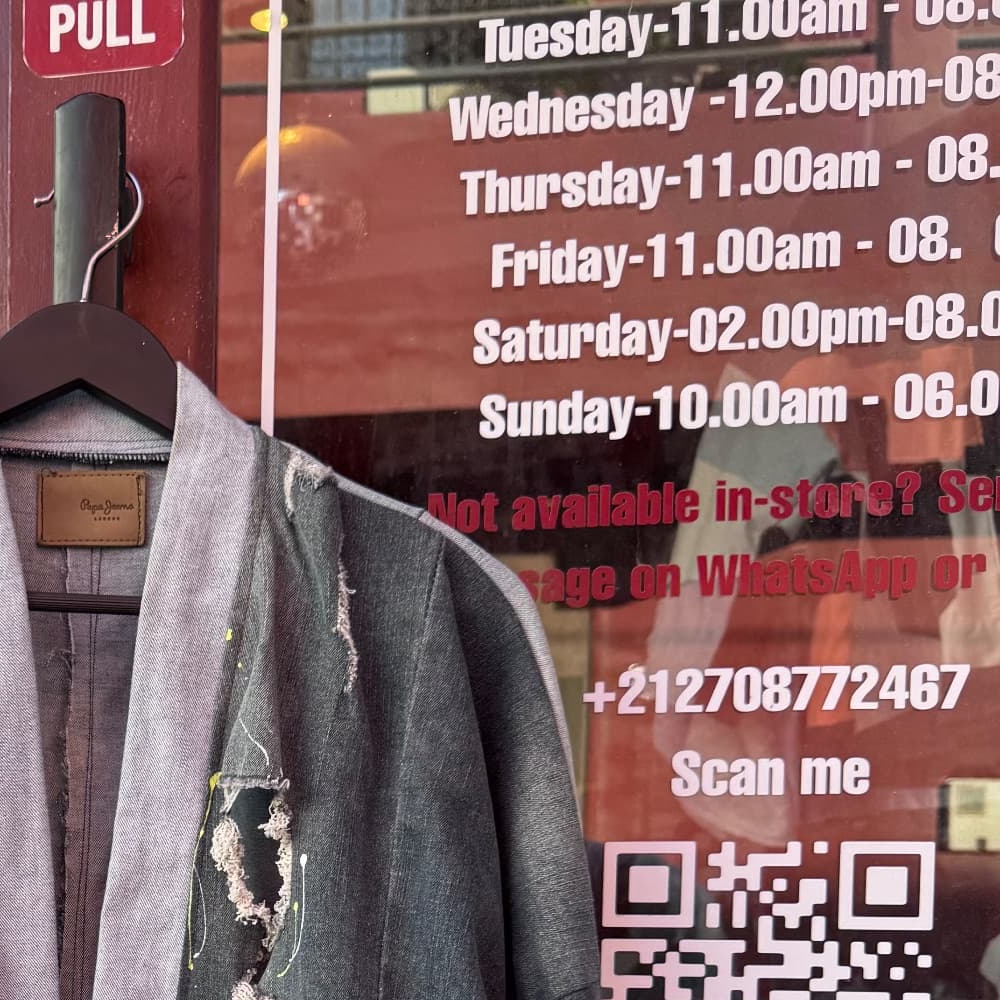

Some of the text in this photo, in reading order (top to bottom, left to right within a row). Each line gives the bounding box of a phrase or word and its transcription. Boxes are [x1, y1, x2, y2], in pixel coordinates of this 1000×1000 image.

[50, 0, 155, 53] PULL
[449, 82, 695, 141] Wednesday
[460, 146, 880, 215] Thursday-11.00am
[491, 226, 841, 288] Friday-11.00am
[479, 379, 847, 439] Sunday-10.00am
[427, 468, 1000, 534] Not available in-store? Se
[630, 562, 680, 598] on
[697, 550, 918, 600] WhatsApp
[934, 553, 987, 592] or
[583, 664, 971, 714] +212708772467
[671, 750, 871, 797] Scan me
